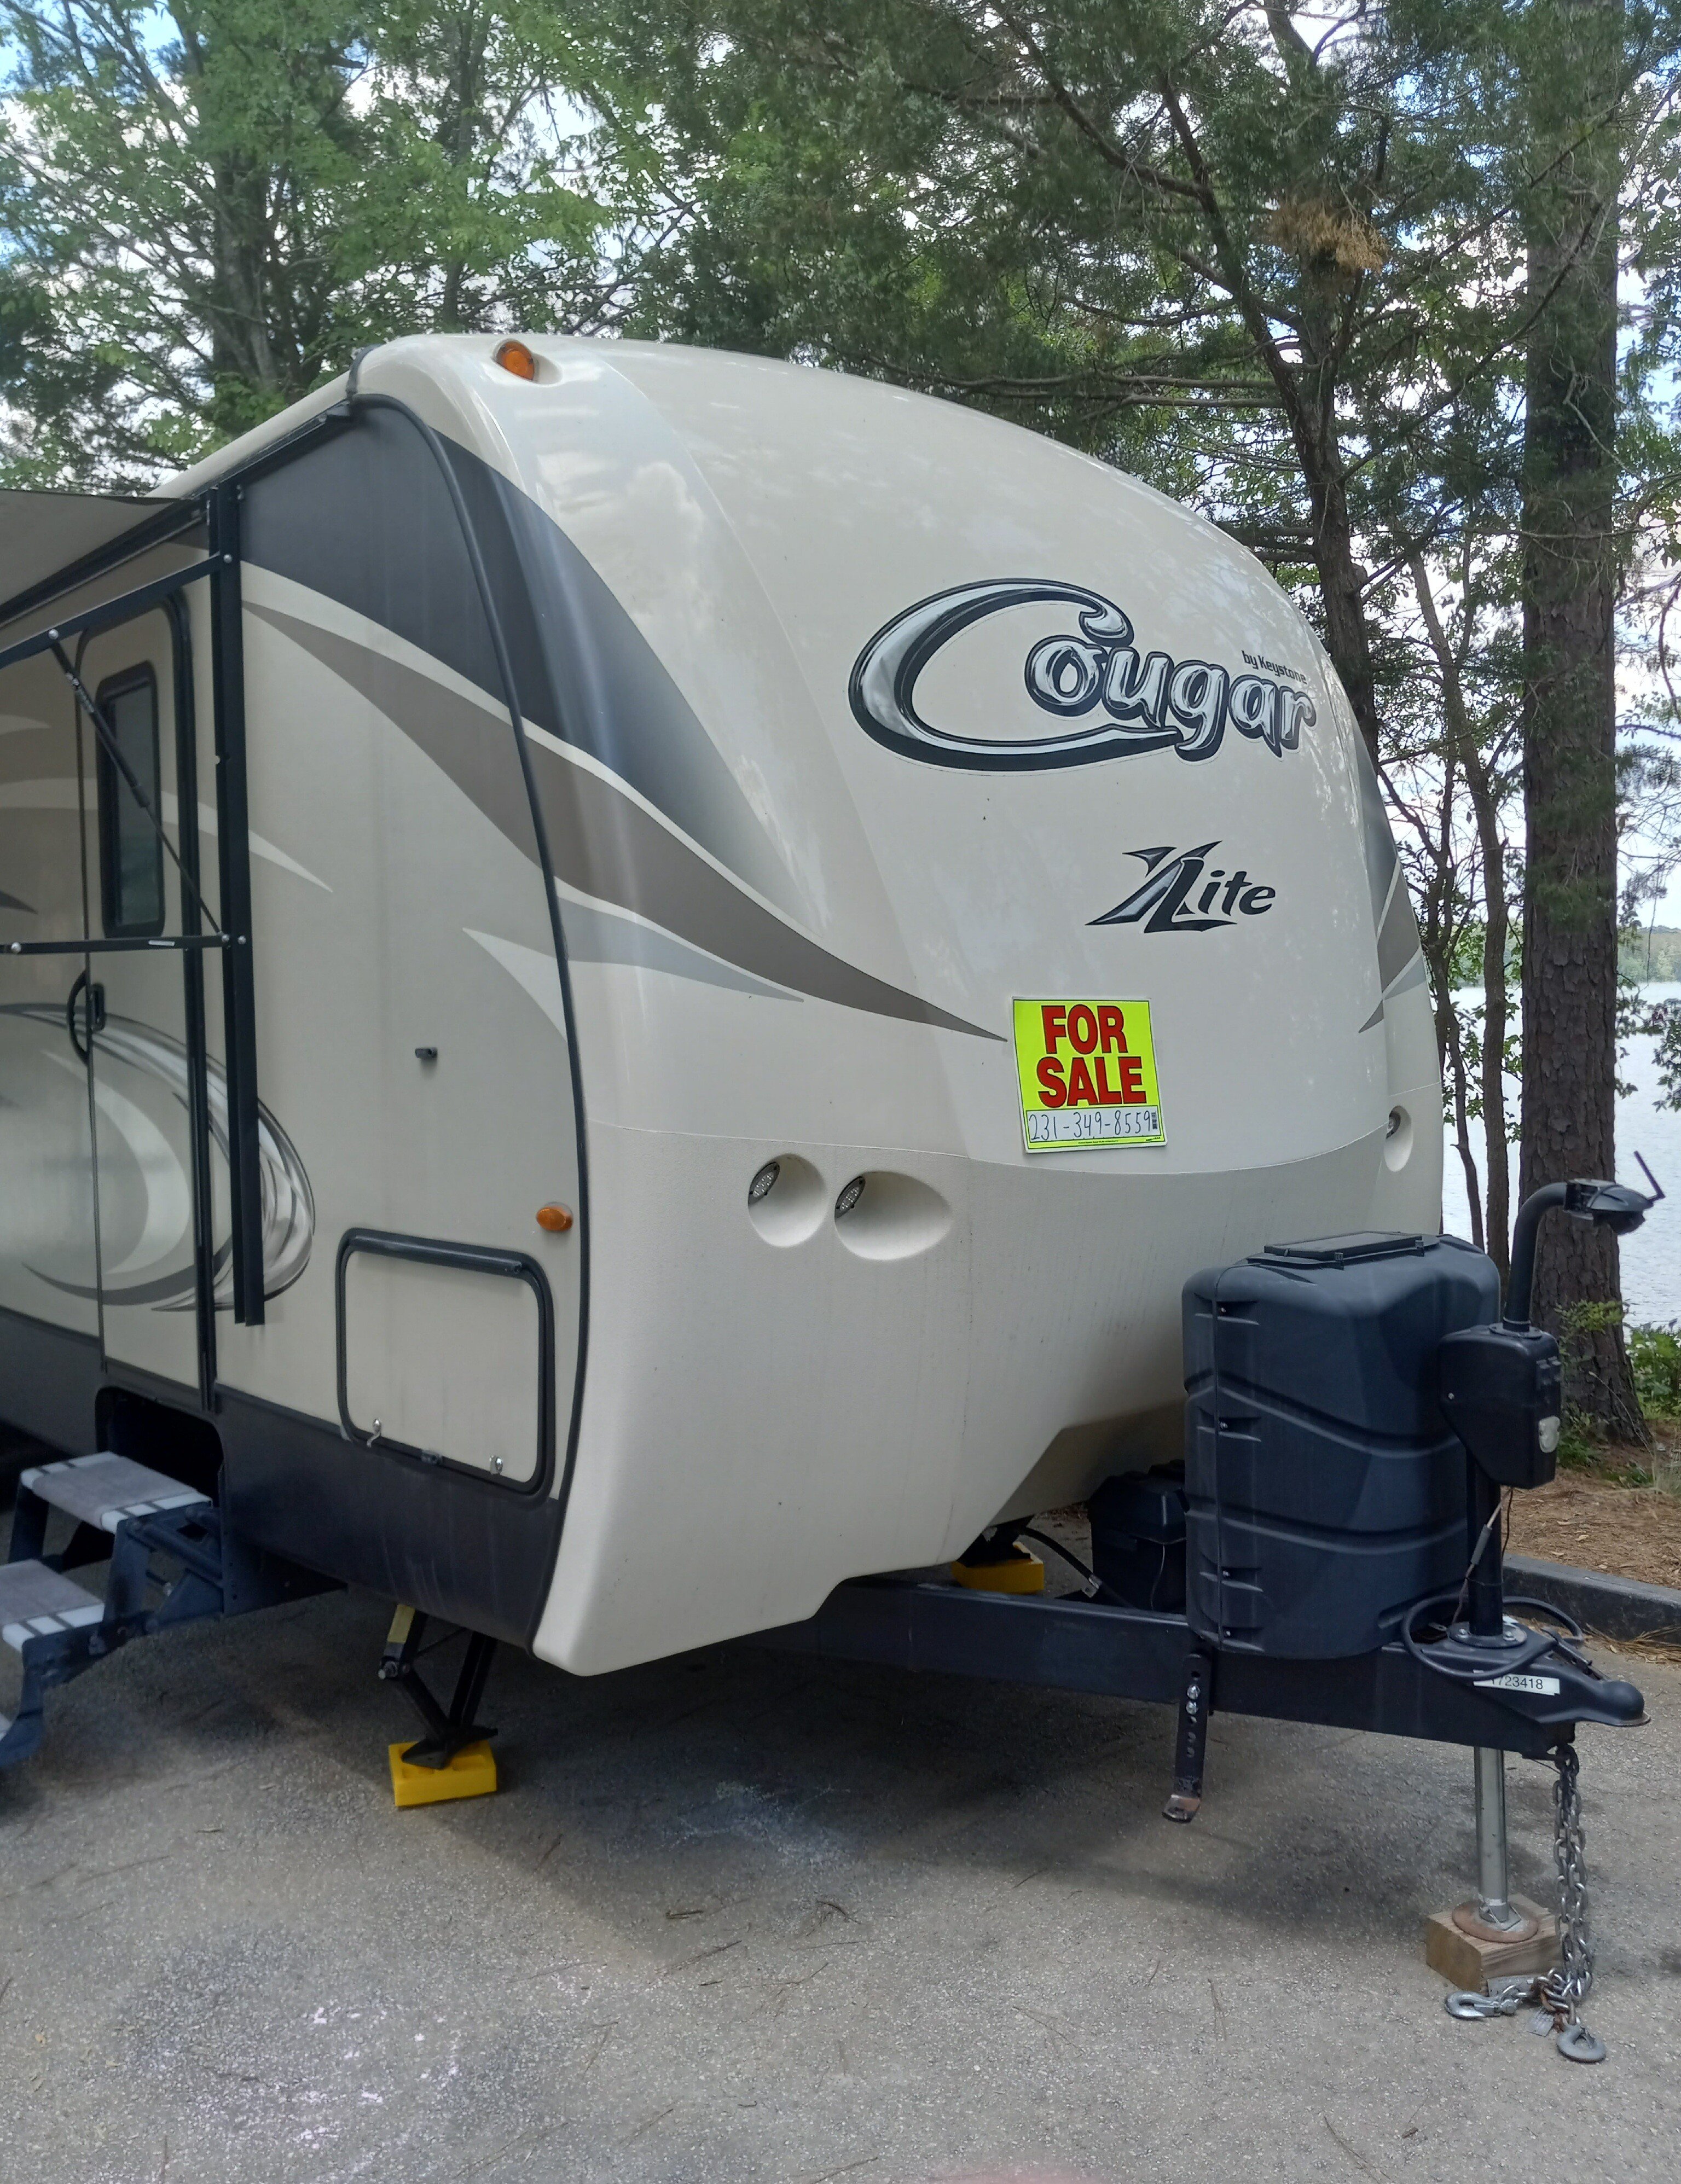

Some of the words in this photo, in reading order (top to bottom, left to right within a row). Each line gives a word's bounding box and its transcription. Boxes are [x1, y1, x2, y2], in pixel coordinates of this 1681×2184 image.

[848, 578, 1316, 771] Cougar
[1242, 650, 1259, 670] by
[1257, 655, 1307, 684] Keystone
[1041, 1004, 1128, 1054] FOR
[1036, 1056, 1146, 1108] SALE
[1029, 1110, 1150, 1140] 231-349-8559
